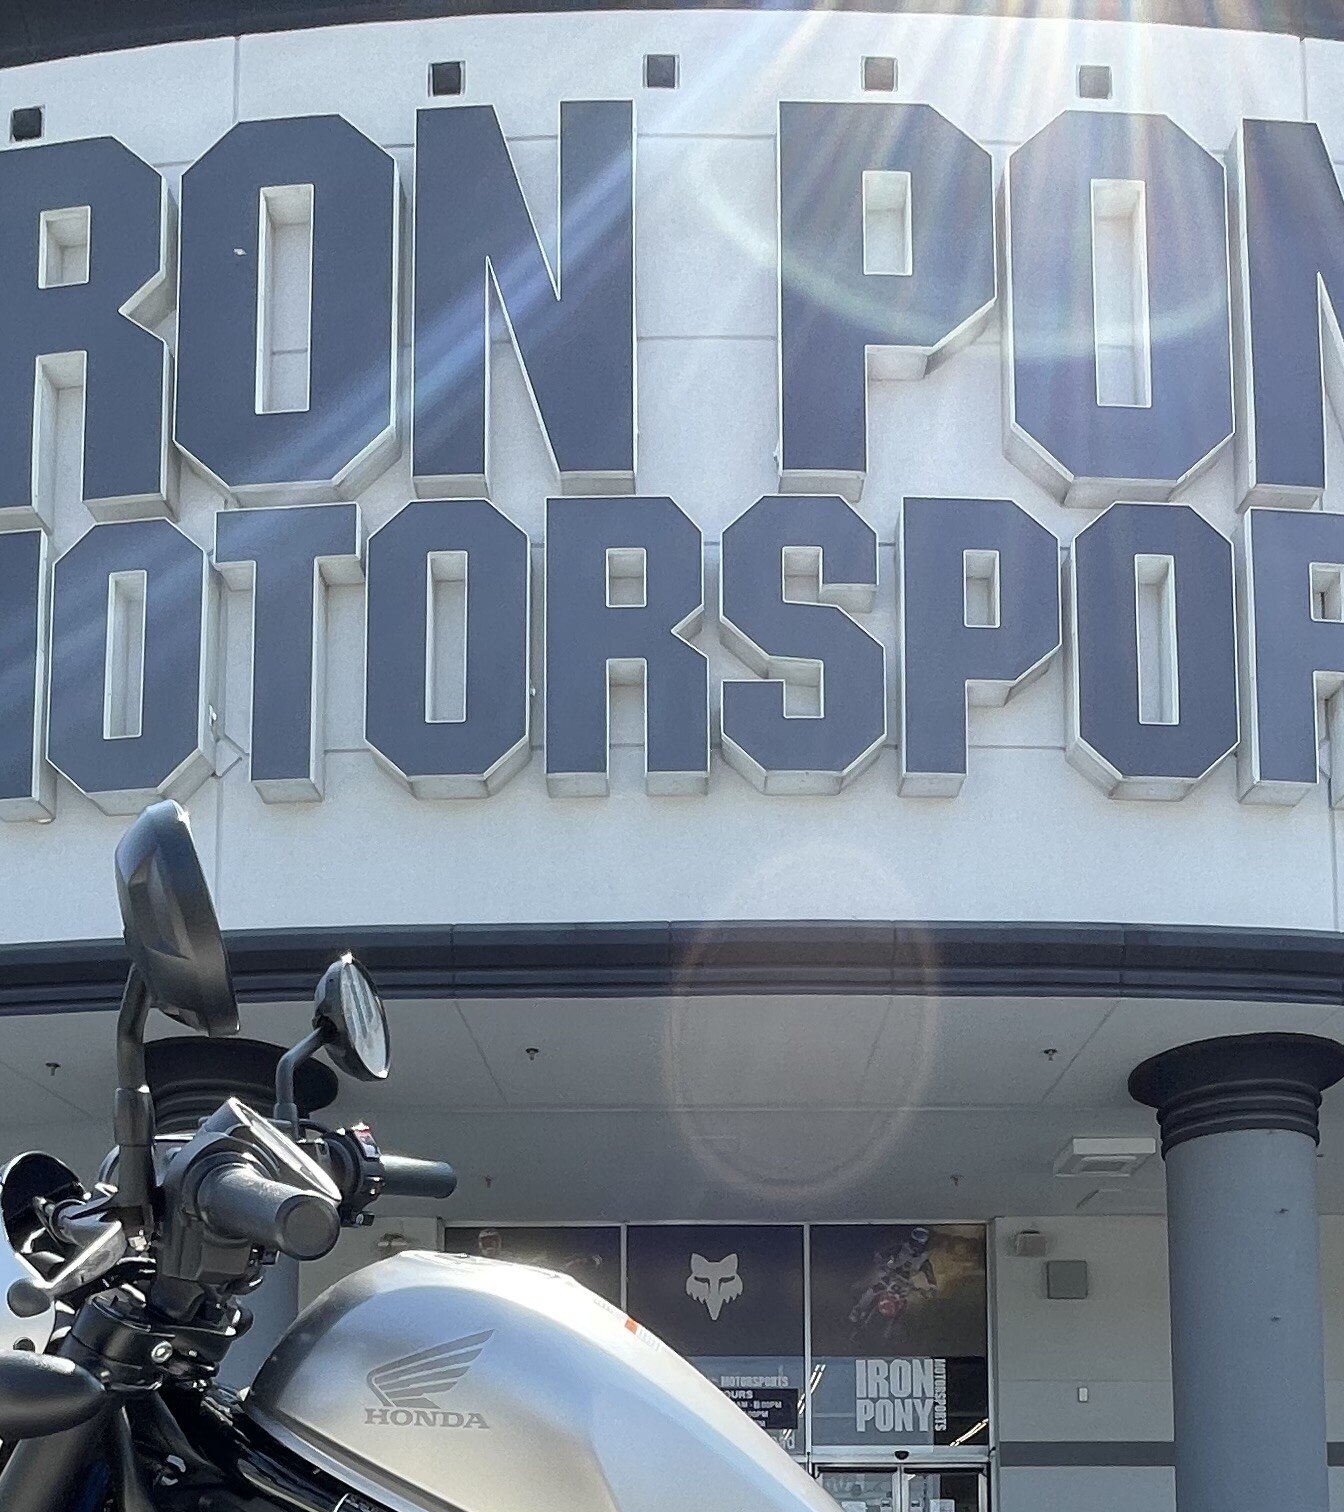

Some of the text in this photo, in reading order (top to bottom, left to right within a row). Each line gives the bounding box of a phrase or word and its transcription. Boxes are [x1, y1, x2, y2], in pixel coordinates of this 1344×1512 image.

[856, 1358, 934, 1398] IRON
[364, 1407, 490, 1429] HONDA
[856, 1398, 934, 1432] PONY
